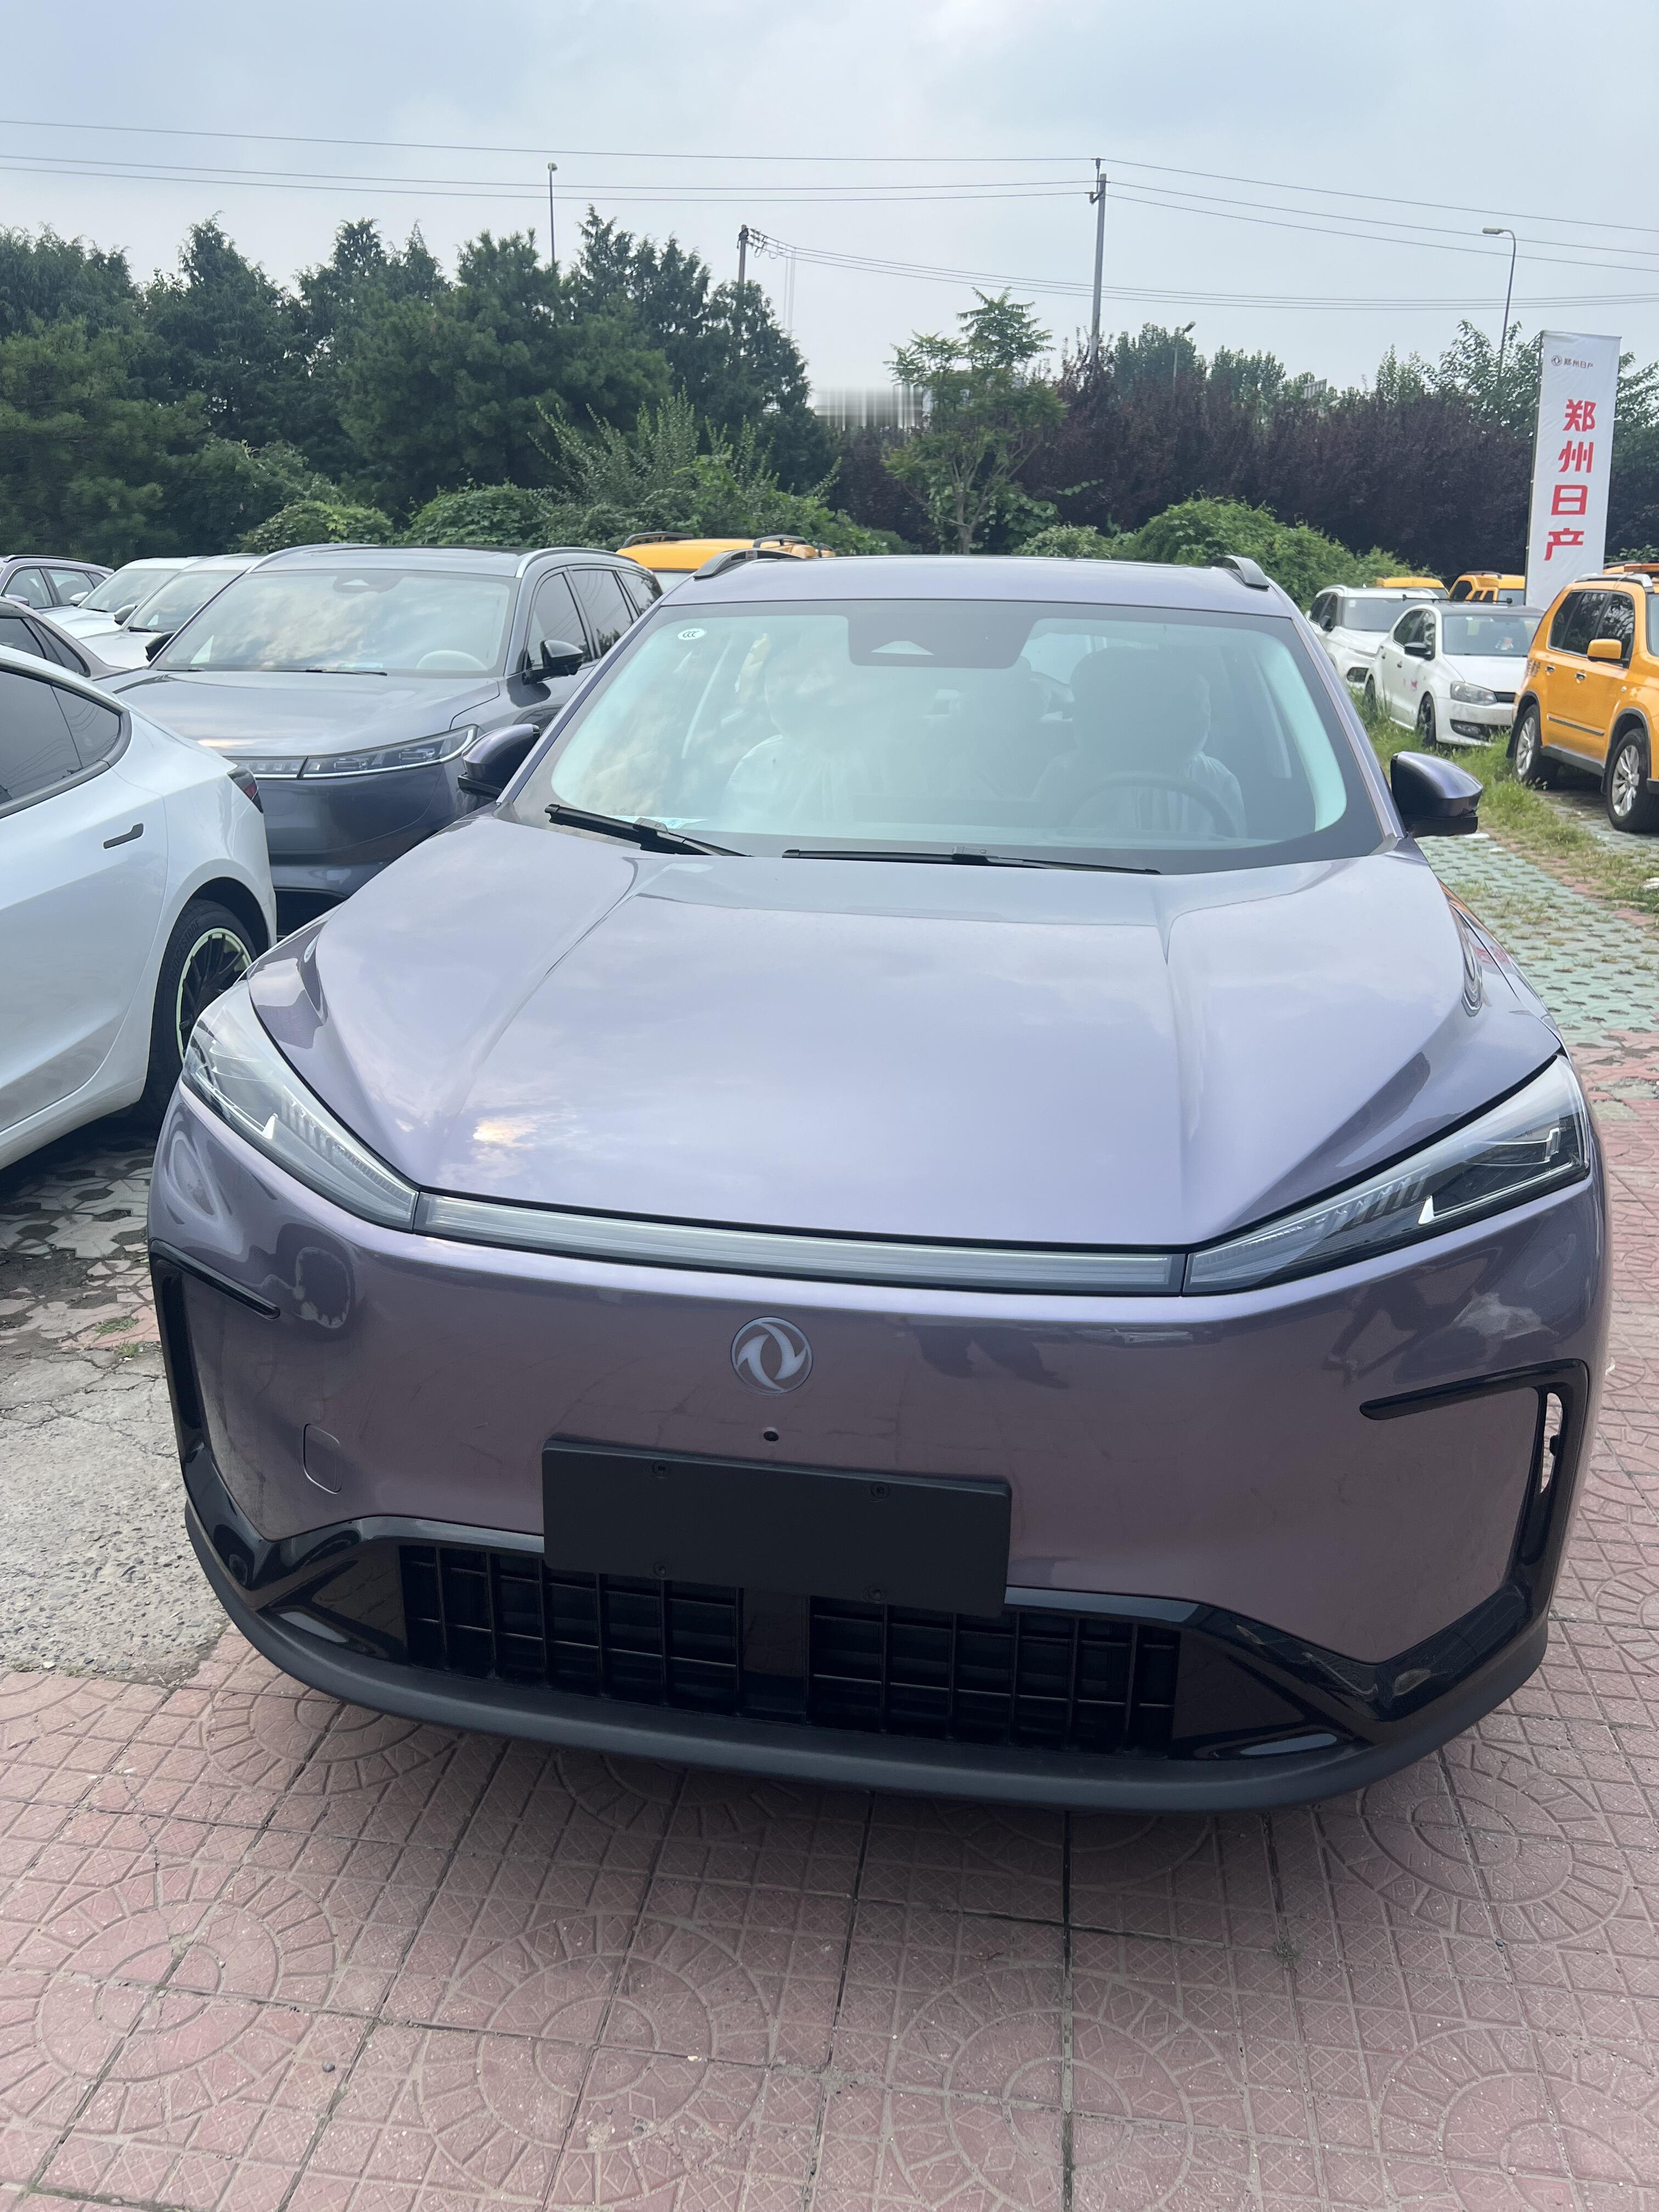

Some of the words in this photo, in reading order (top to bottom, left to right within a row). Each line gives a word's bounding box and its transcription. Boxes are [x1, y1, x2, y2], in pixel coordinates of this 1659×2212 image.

[1564, 358, 1594, 369] 郑州日产
[1544, 399, 1597, 561] 郑州日产
